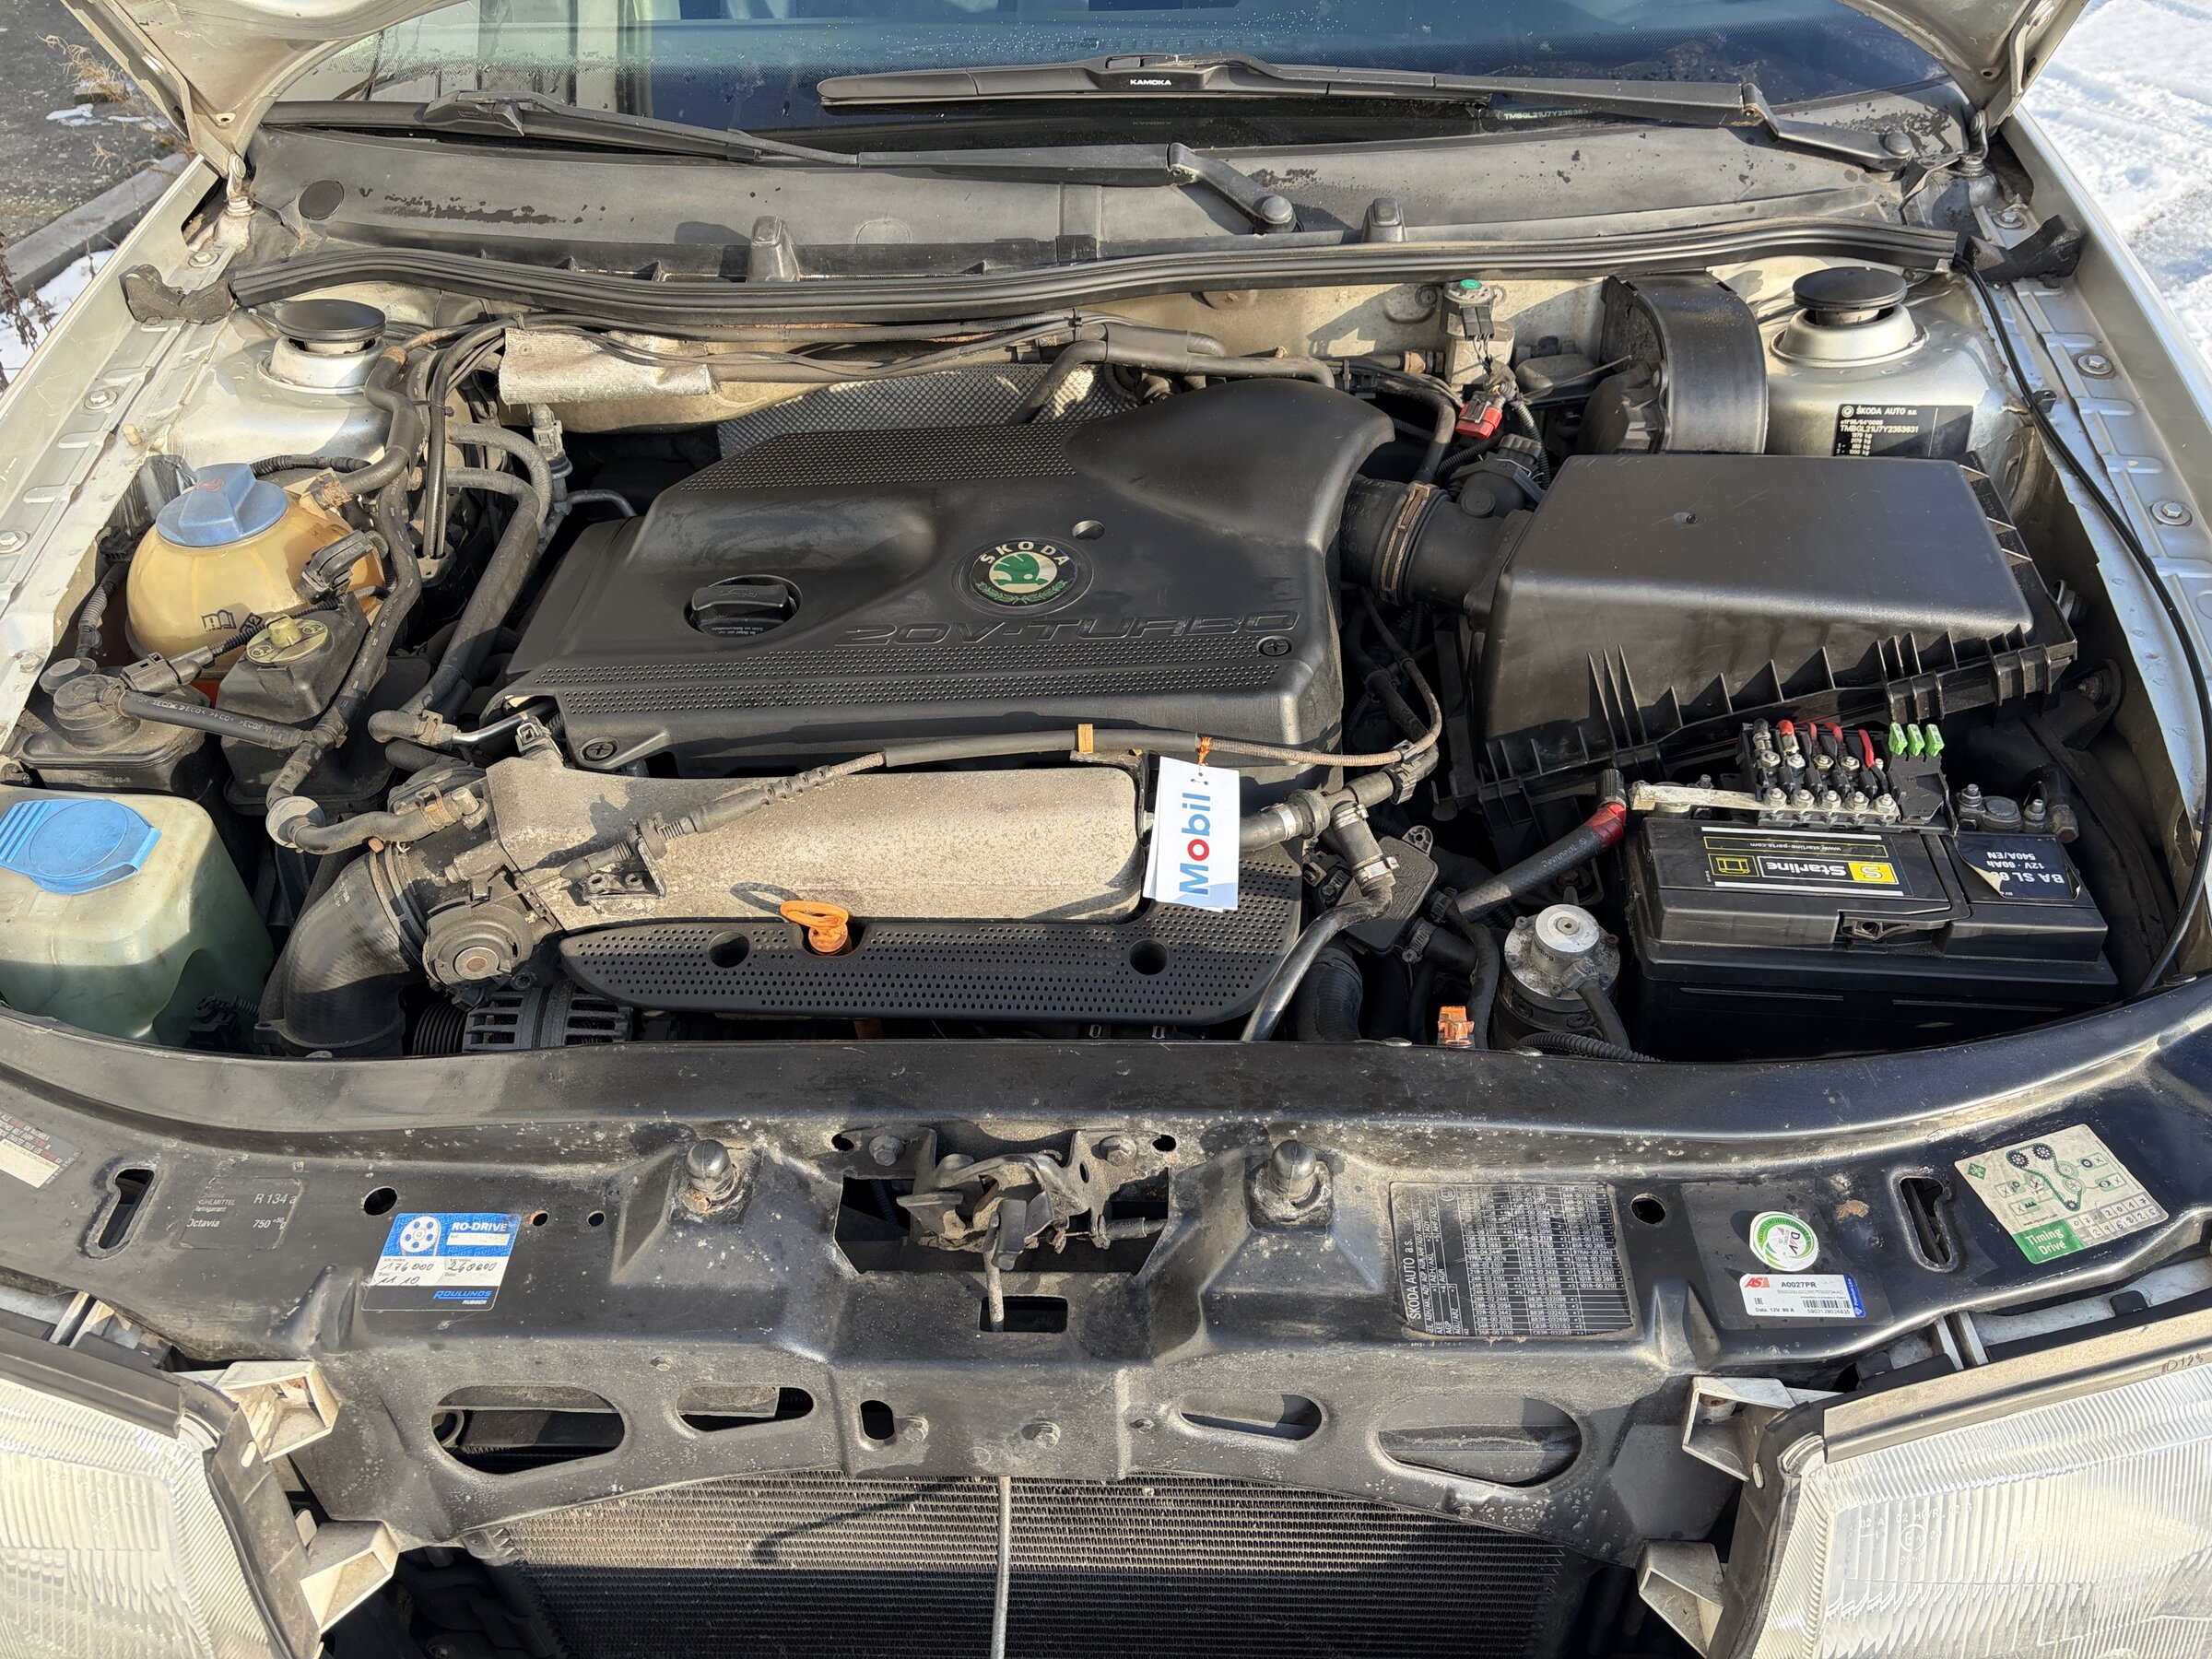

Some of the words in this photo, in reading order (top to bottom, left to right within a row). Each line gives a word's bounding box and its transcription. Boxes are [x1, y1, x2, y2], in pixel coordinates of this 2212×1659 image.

[1179, 793, 1210, 895] Mobil
[1987, 852, 2036, 861] 540A/EN
[1766, 862, 1847, 876] Starline
[1986, 860, 2016, 868] 60Ah
[2012, 872, 2035, 882] SL
[2038, 874, 2065, 884] BA
[253, 1194, 265, 1204] R
[266, 1194, 288, 1204] 134
[253, 1219, 270, 1229] 750
[452, 1222, 508, 1232] RO-DRIVE
[2025, 1228, 2065, 1246] Timing
[2037, 1240, 2067, 1255] Drive
[1403, 1257, 1418, 1285] AUTO
[433, 1290, 493, 1300] ROULUNDS
